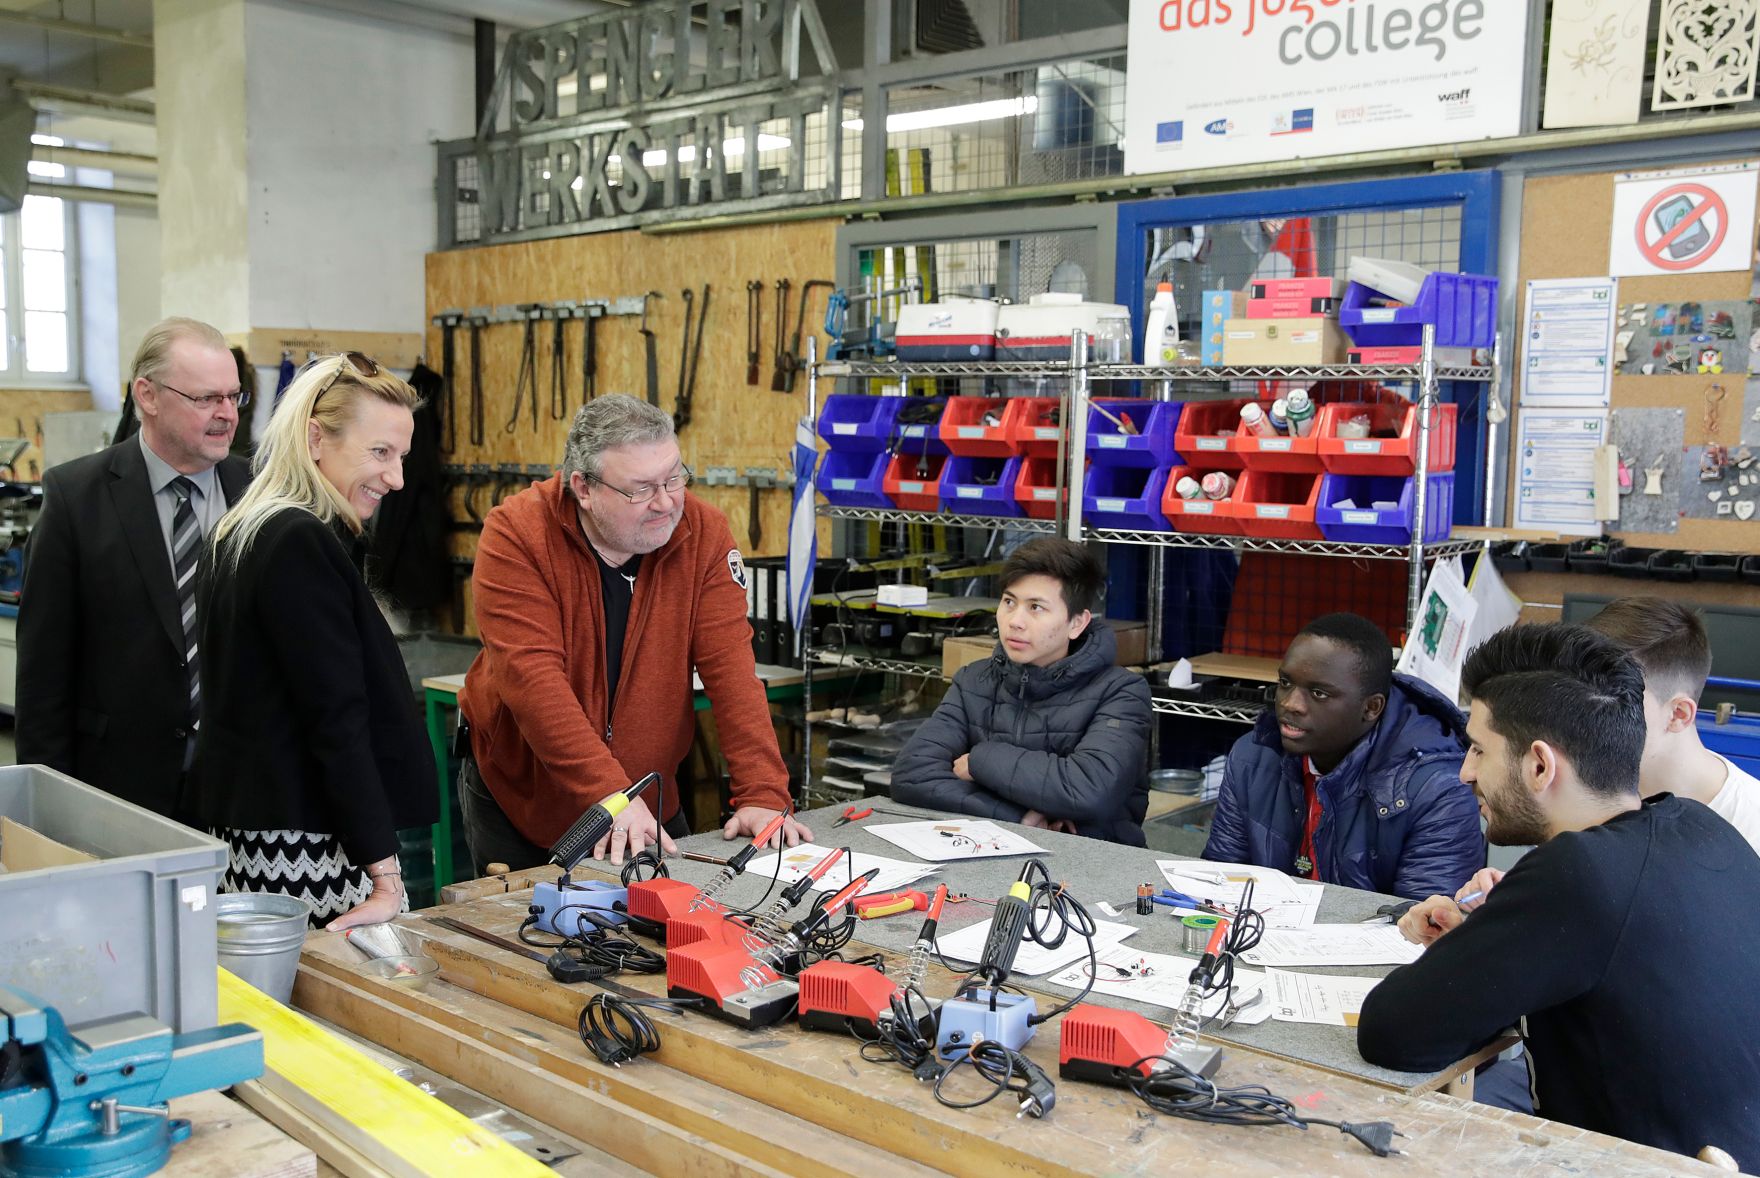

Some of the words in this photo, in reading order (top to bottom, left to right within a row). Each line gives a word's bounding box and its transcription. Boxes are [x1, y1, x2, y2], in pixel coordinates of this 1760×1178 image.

[1279, 0, 1484, 64] college
[1437, 88, 1470, 102] waff
[477, 98, 826, 232] WERKSTATT
